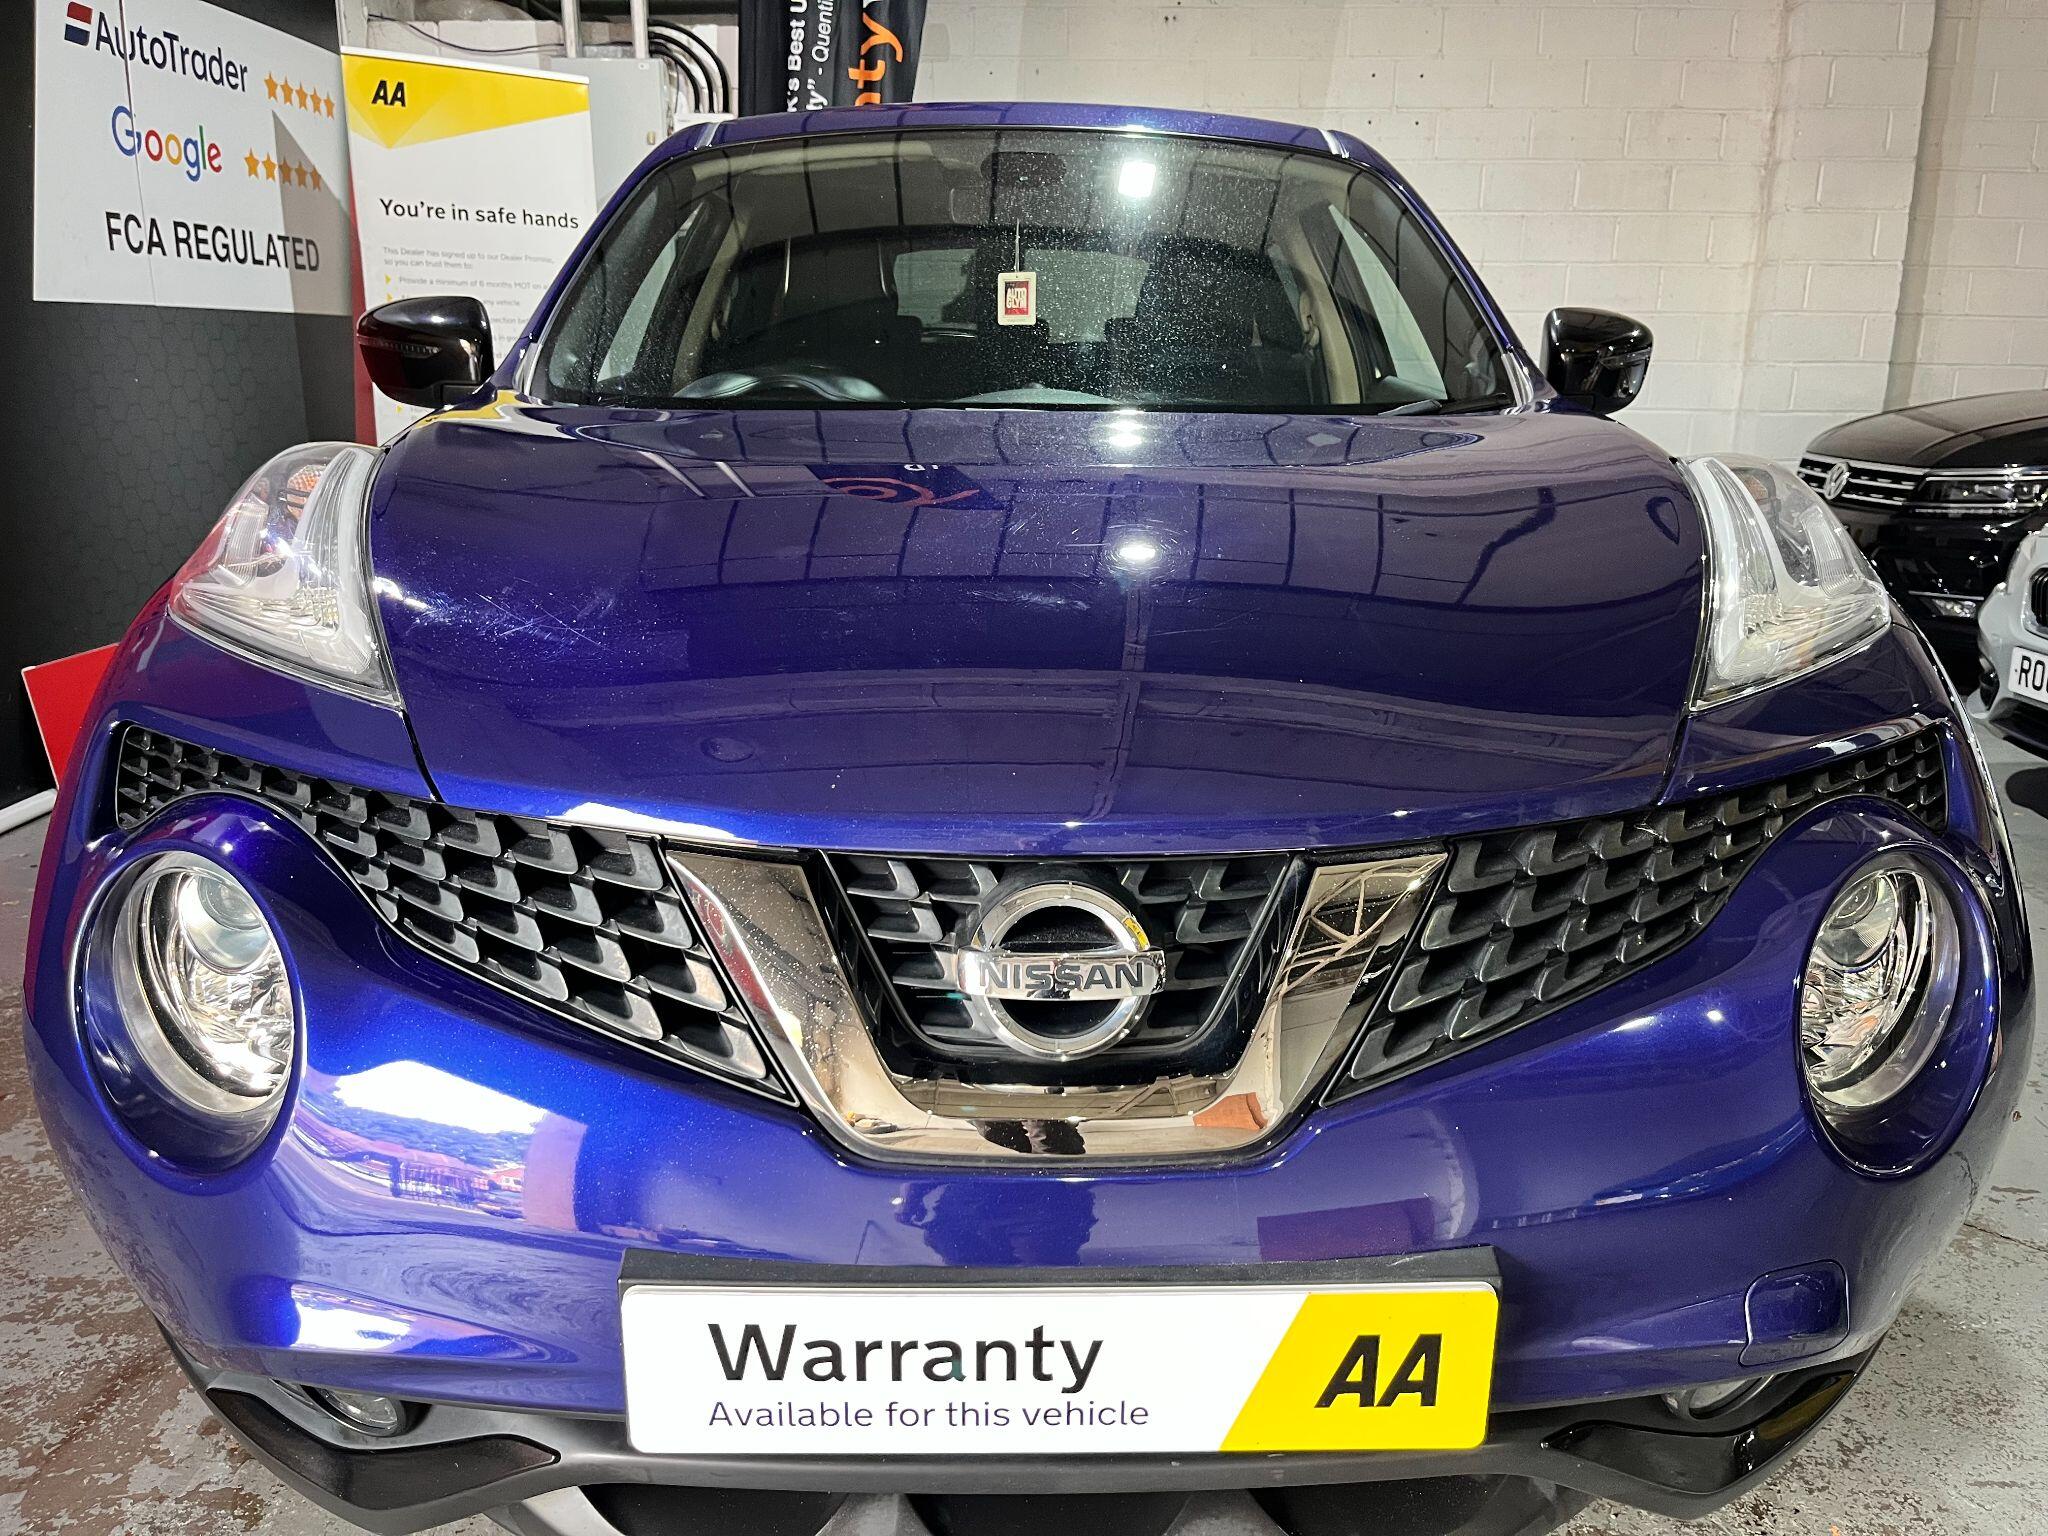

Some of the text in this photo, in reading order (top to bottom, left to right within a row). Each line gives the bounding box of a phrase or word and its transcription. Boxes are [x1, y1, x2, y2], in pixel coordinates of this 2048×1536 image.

[96, 11, 248, 92] AutoTrader
[787, 20, 806, 71] Best
[811, 0, 834, 63] Quenti
[371, 80, 406, 107] AA
[111, 105, 222, 182] Google
[105, 211, 320, 272] FCA REGULATED
[380, 198, 579, 229] You're in safe hands
[2018, 655, 2048, 693] RO
[980, 962, 1144, 989] NISSAN
[708, 1324, 1103, 1393] Warranty
[1314, 1333, 1442, 1407] AA
[709, 1401, 1149, 1426] Available for this vehicle
